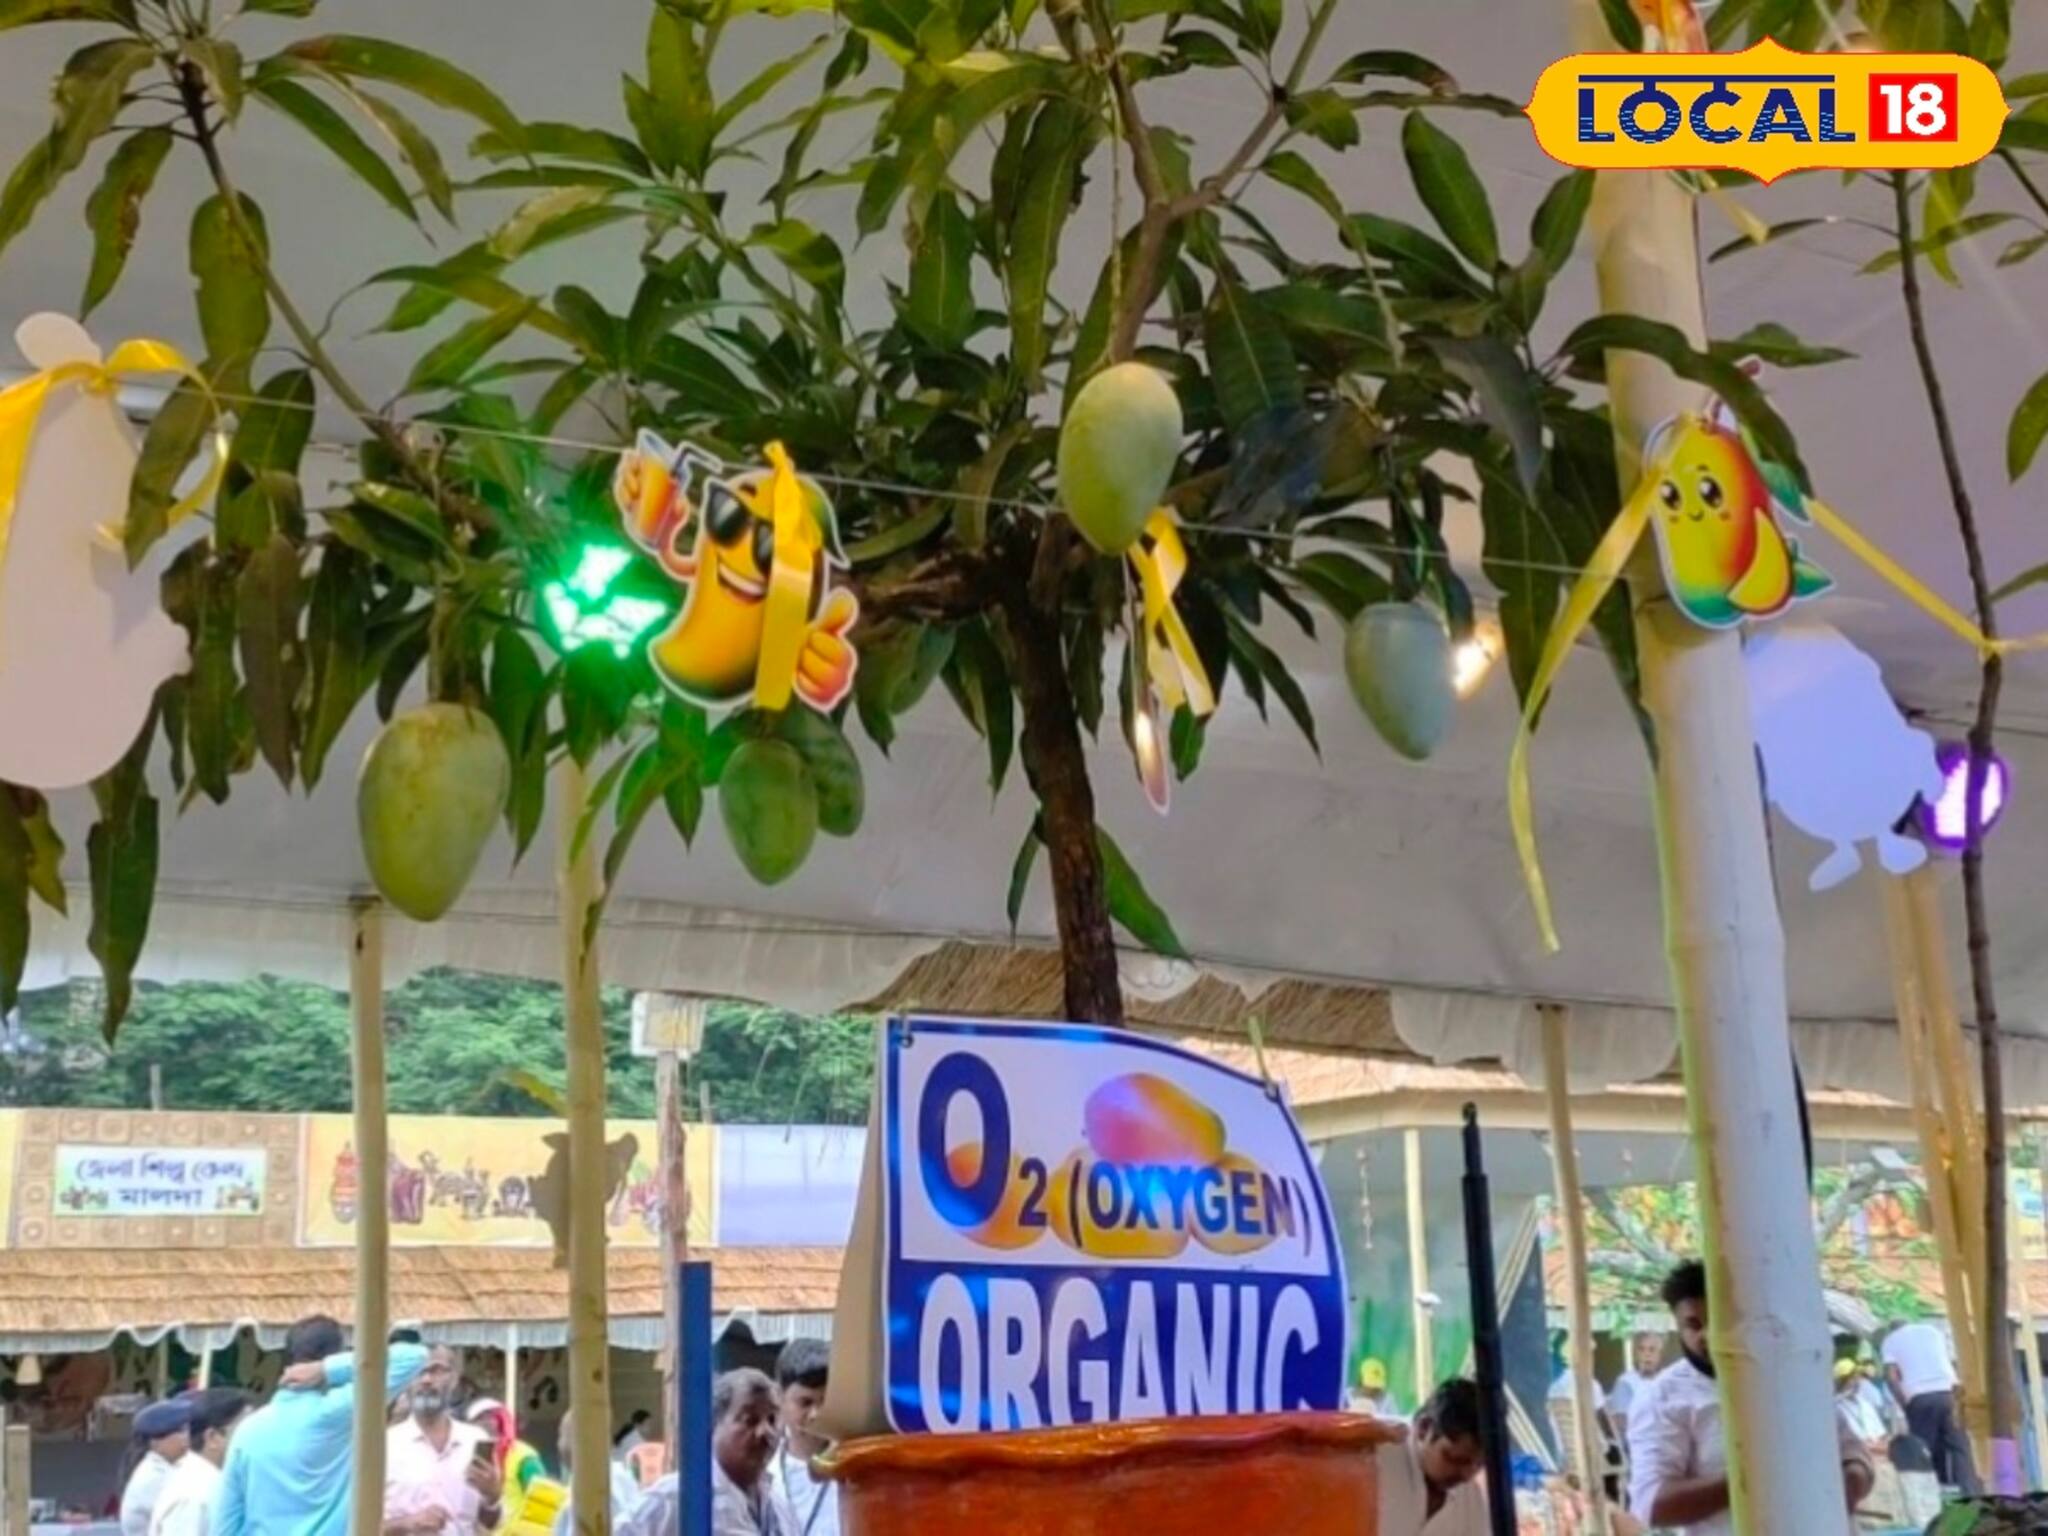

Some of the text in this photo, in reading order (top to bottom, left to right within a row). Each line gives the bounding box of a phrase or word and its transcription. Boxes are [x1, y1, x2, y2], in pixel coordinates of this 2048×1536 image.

[77, 1157, 133, 1181] জেলা
[1070, 1160, 1312, 1256] (OXYGEN)
[921, 1272, 1320, 1433] ORGANIC
